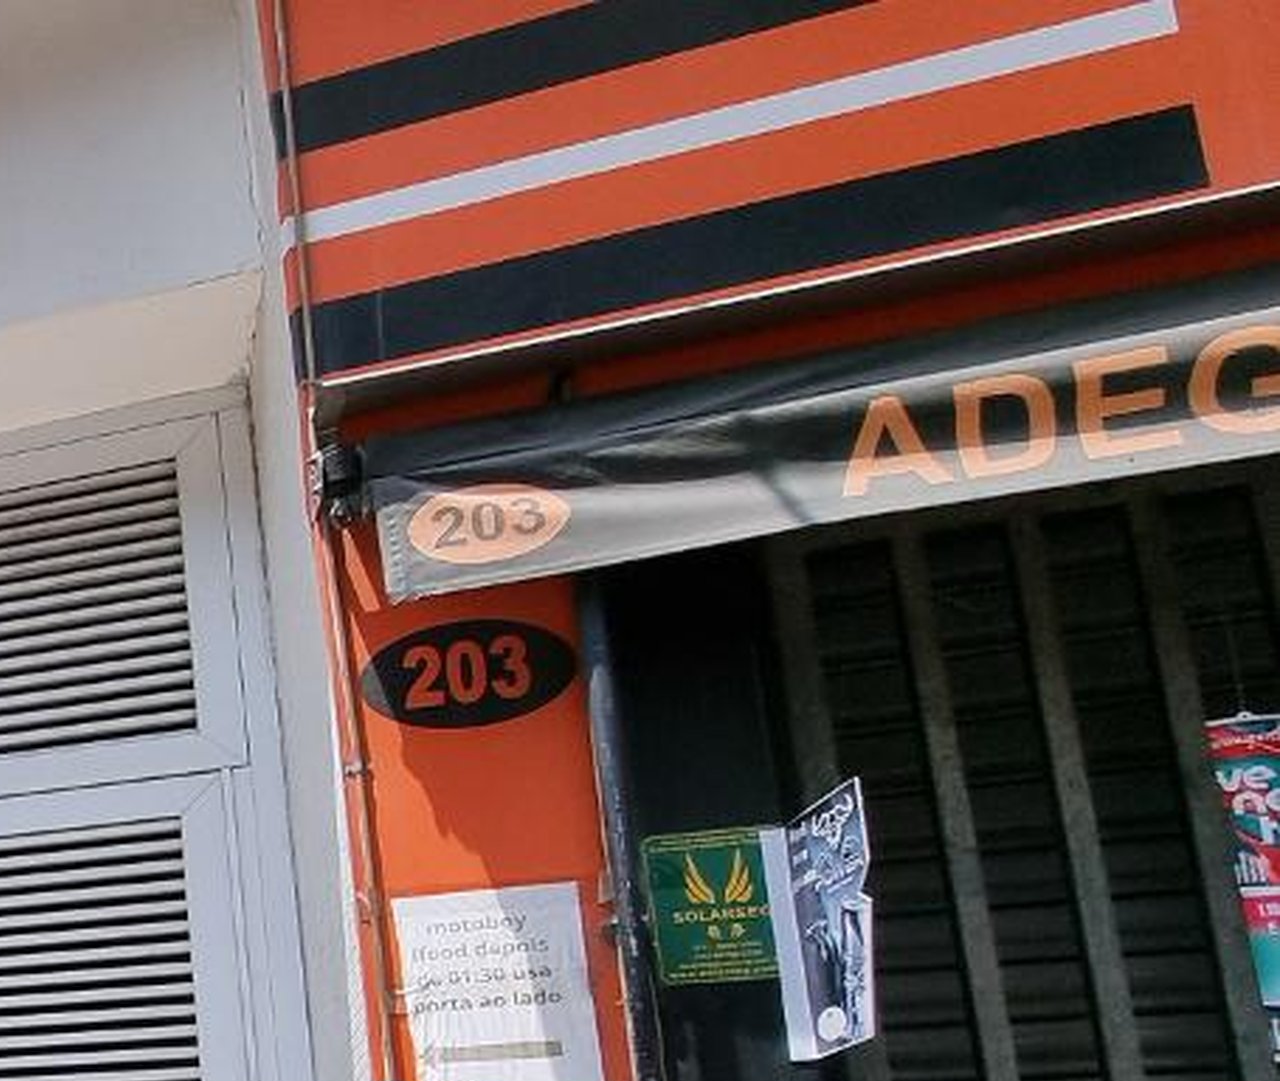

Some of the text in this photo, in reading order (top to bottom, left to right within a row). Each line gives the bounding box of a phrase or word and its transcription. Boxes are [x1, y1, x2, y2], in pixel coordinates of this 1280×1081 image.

[842, 324, 1280, 497] ADEG
[430, 498, 546, 549] 203
[402, 634, 531, 710] 203
[513, 989, 564, 1006] lado
